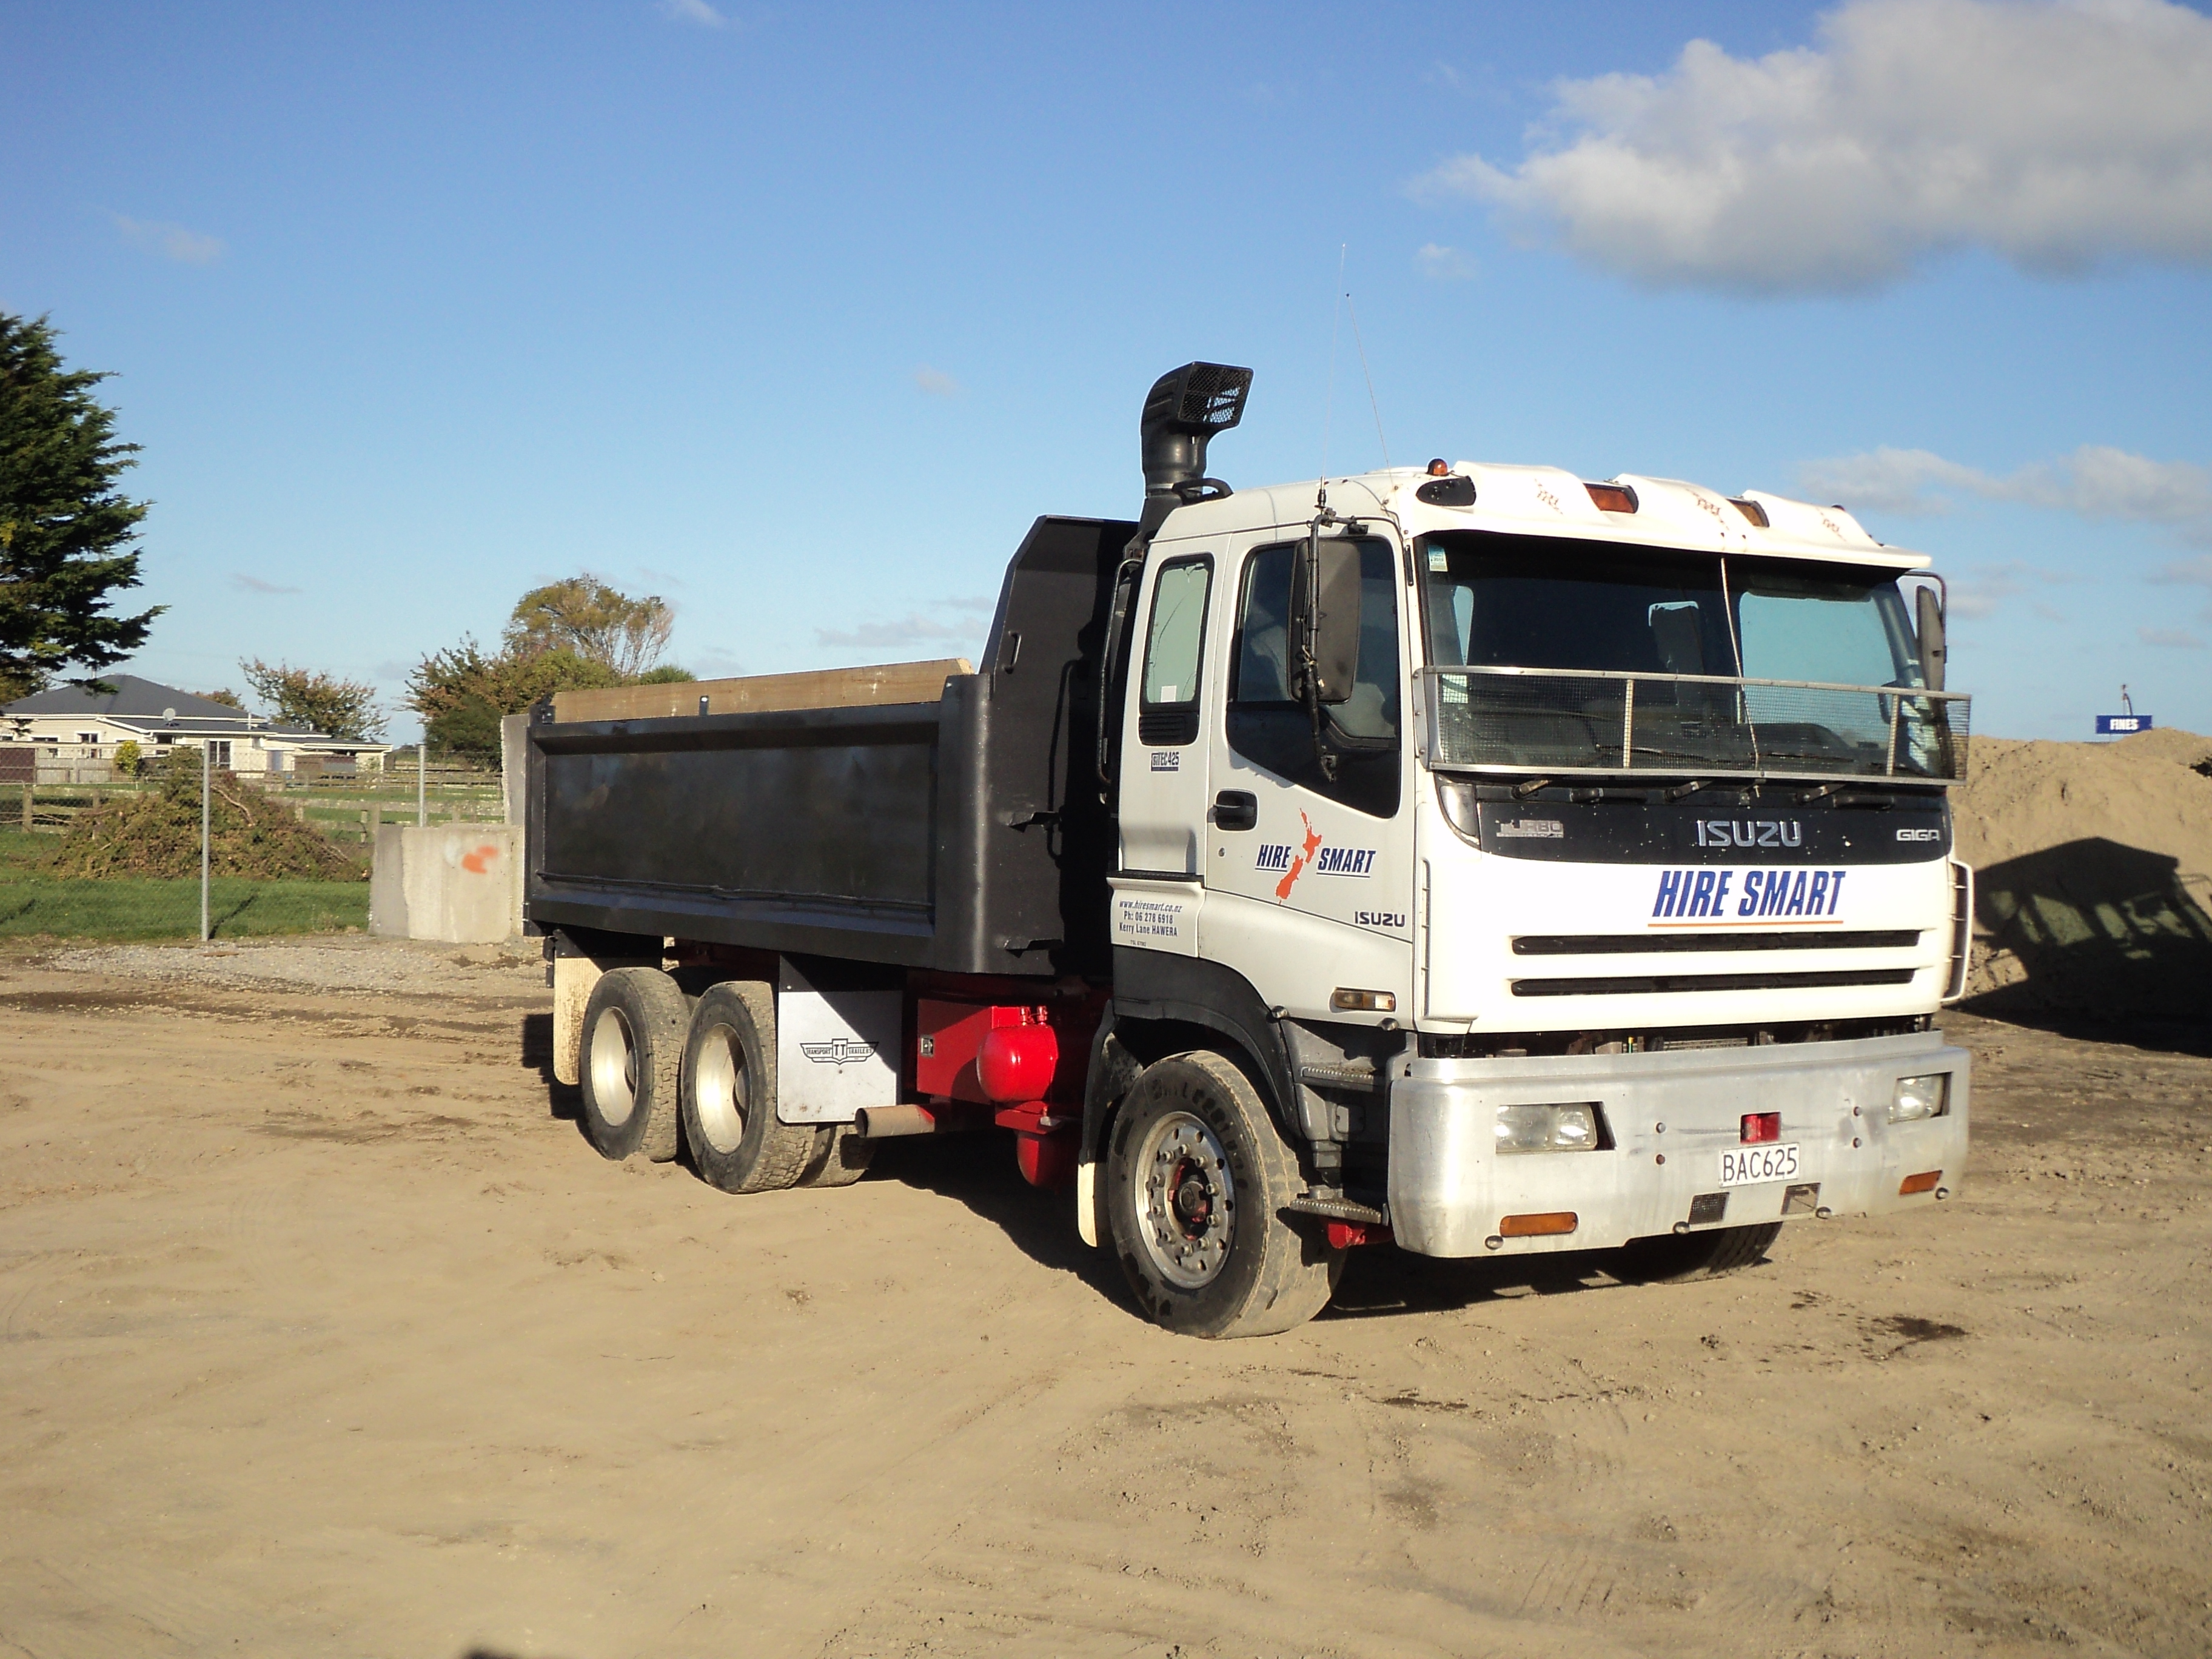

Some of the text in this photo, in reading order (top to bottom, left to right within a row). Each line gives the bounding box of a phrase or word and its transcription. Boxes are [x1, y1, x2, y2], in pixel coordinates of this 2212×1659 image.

[1697, 820, 1801, 847] ISUZU
[1896, 829, 1940, 841] GIGA
[1256, 844, 1376, 873] HIRE SMART
[1652, 871, 1846, 917] HIRE SMART
[1119, 900, 1182, 913] www.hiresmart.co.nz
[1124, 911, 1173, 924] Ph: 06 278 6918
[1355, 911, 1405, 927] ISUZU
[1119, 922, 1178, 936] Kerry Lane HAWERA
[1723, 1147, 1797, 1182] BAC625
